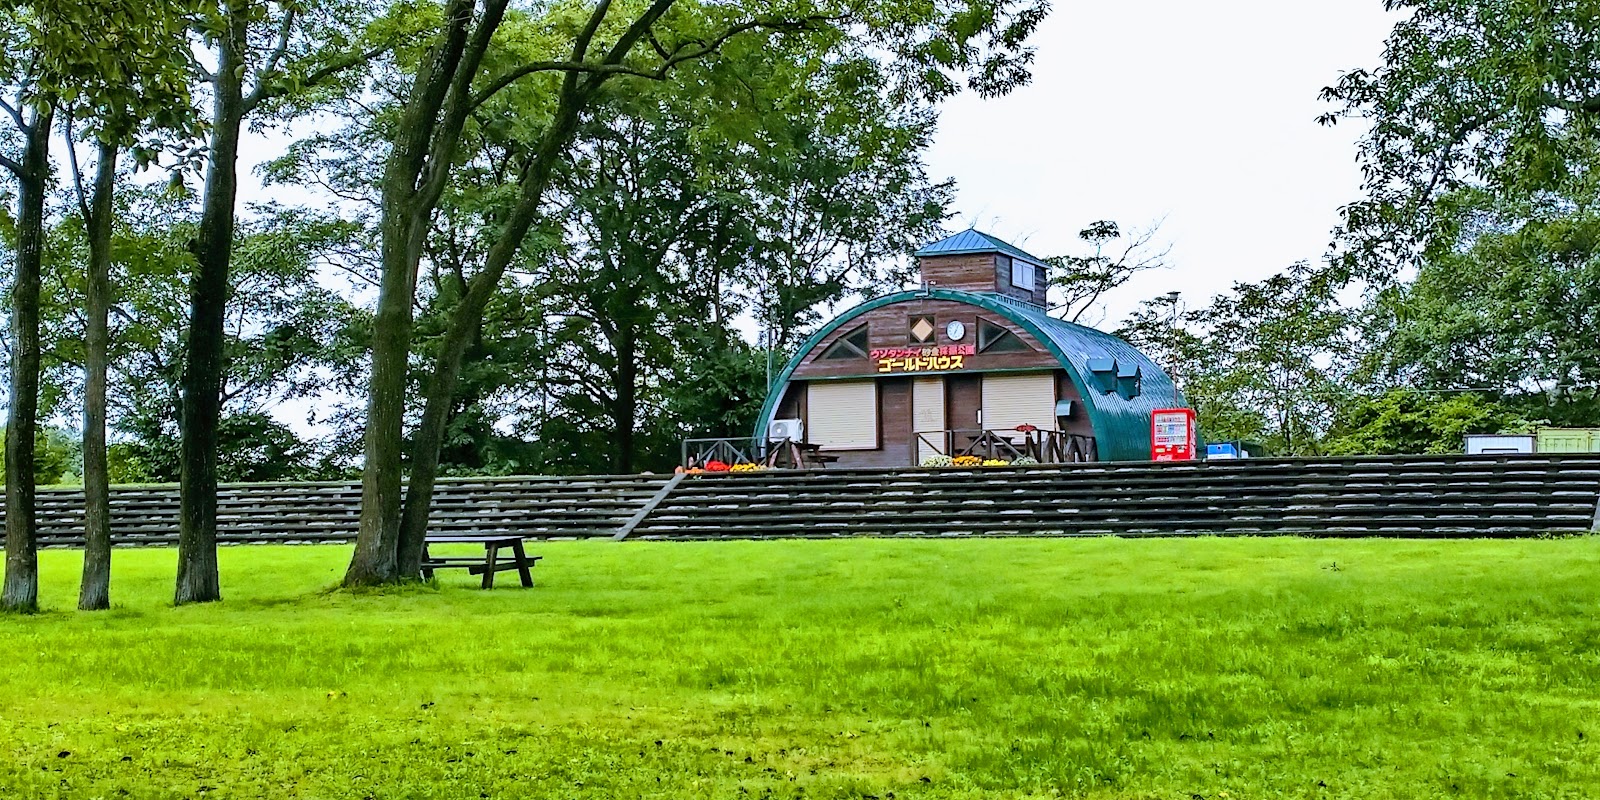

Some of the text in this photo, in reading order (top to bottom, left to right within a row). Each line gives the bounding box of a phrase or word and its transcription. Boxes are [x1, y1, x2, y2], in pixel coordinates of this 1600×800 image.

[878, 355, 964, 372] ゴールドハウス
